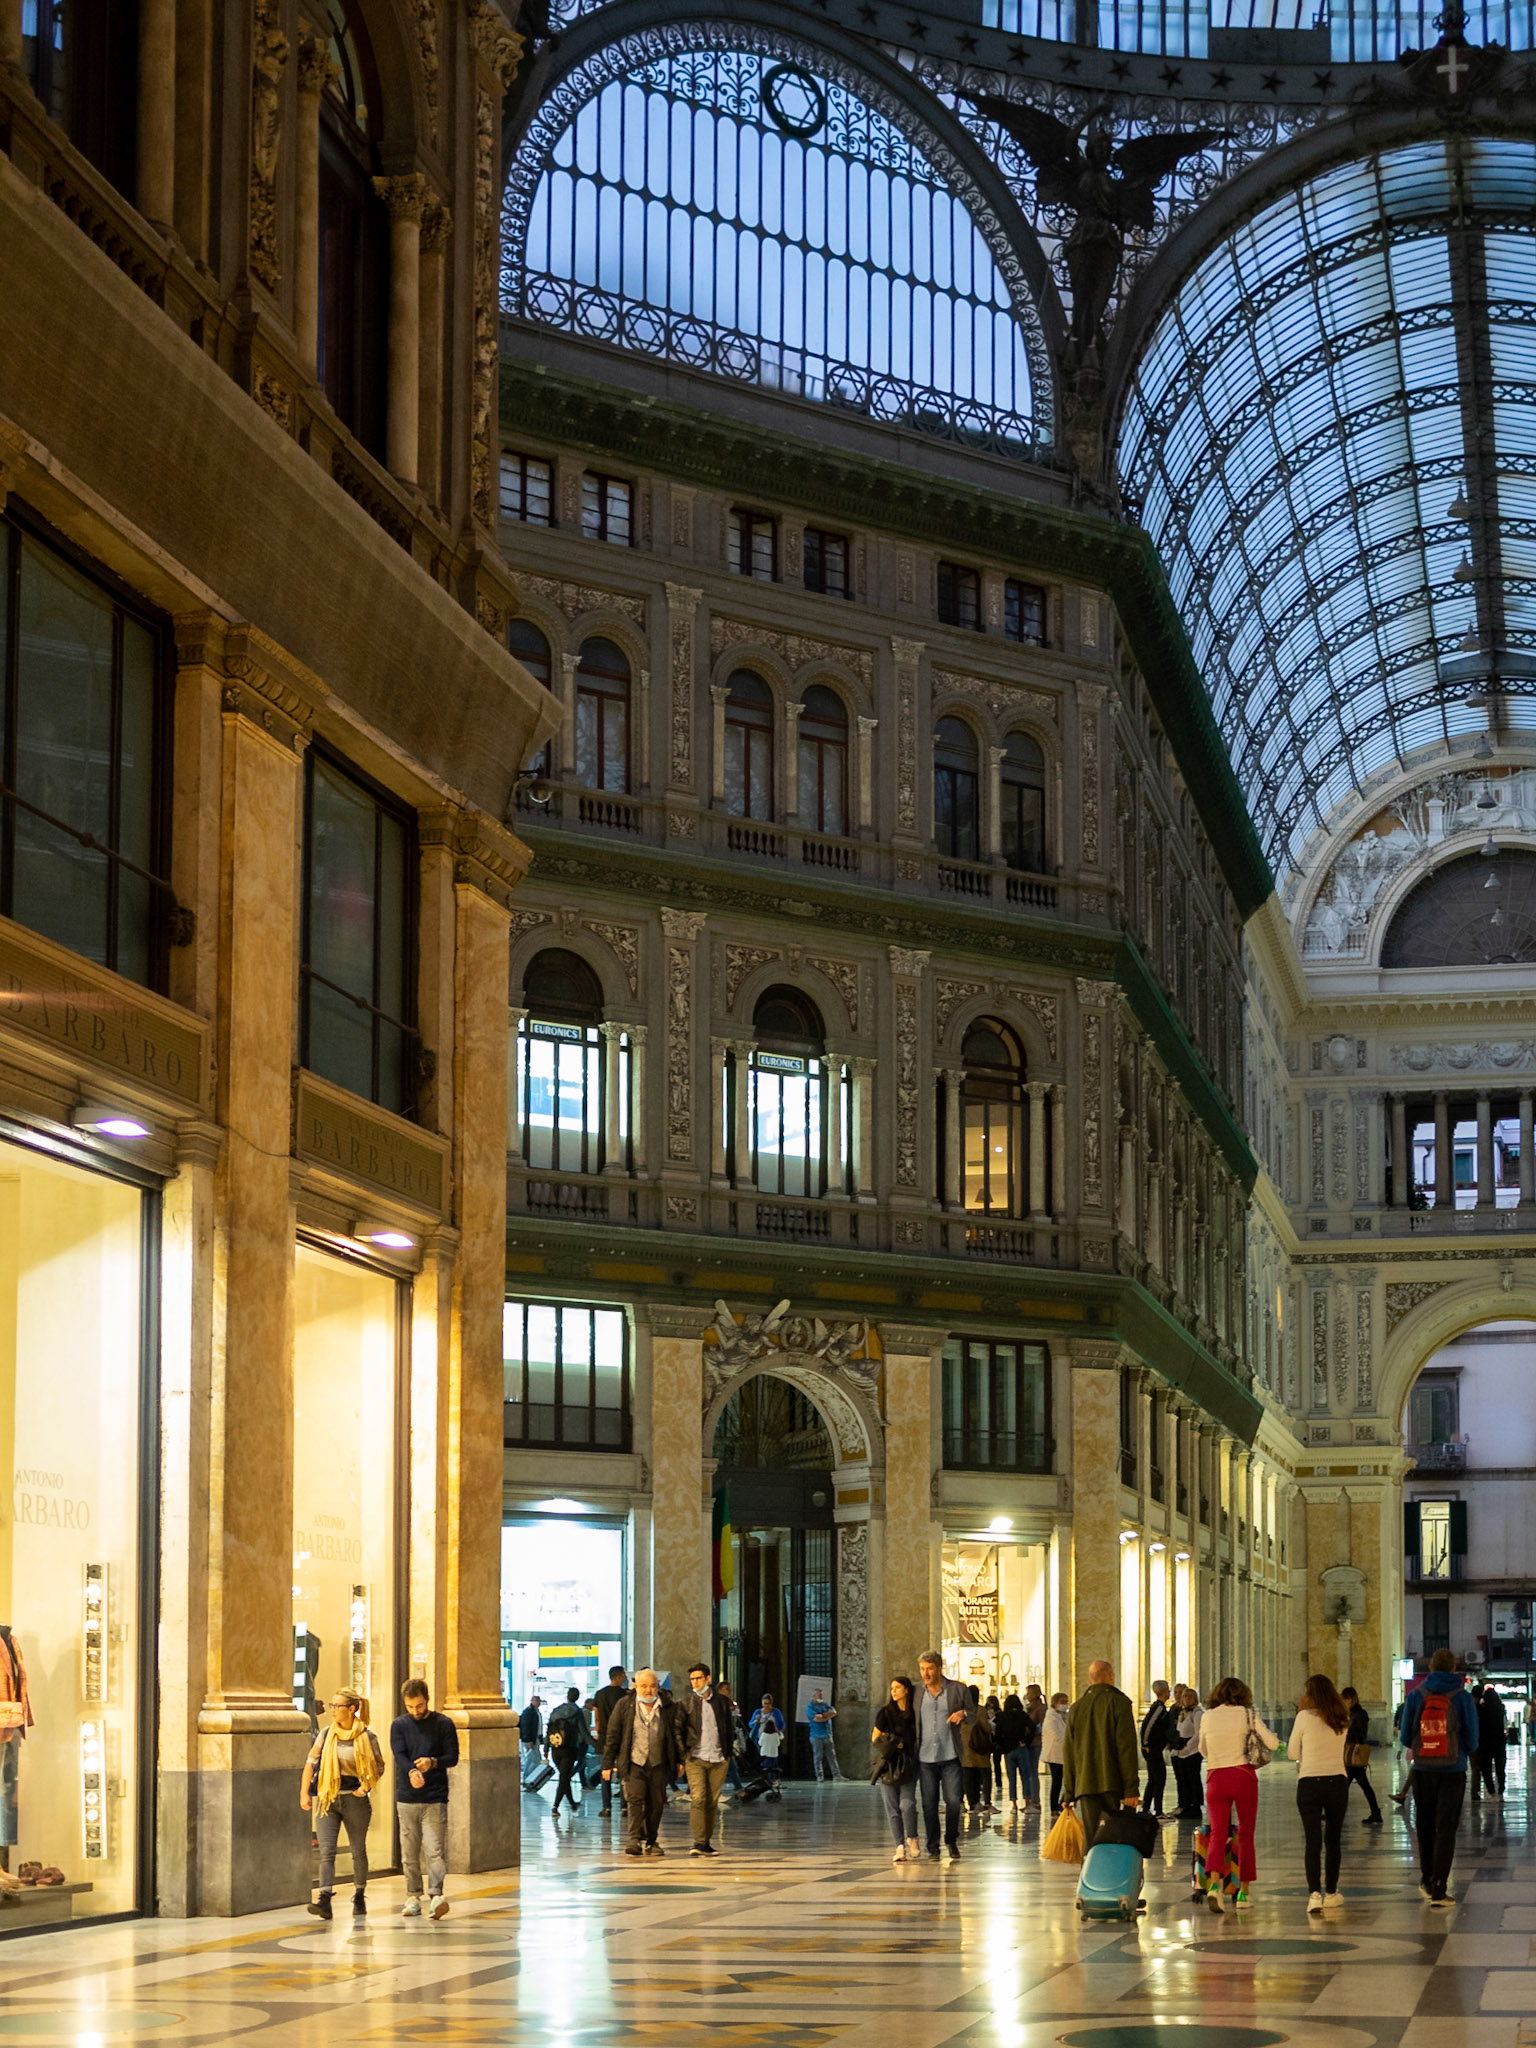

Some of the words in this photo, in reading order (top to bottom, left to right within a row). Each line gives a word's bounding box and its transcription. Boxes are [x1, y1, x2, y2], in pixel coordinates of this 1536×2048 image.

[7, 974, 183, 1087] BARBARO
[534, 1023, 578, 1039] EURONICS
[761, 1056, 801, 1070] EURONICS
[312, 1118, 430, 1197] BARBARO
[14, 1469, 64, 1490] ANTONIO
[296, 1530, 363, 1565] BARBARO
[945, 1597, 993, 1605] TEMPORARY
[960, 1606, 993, 1615] OUTLET
